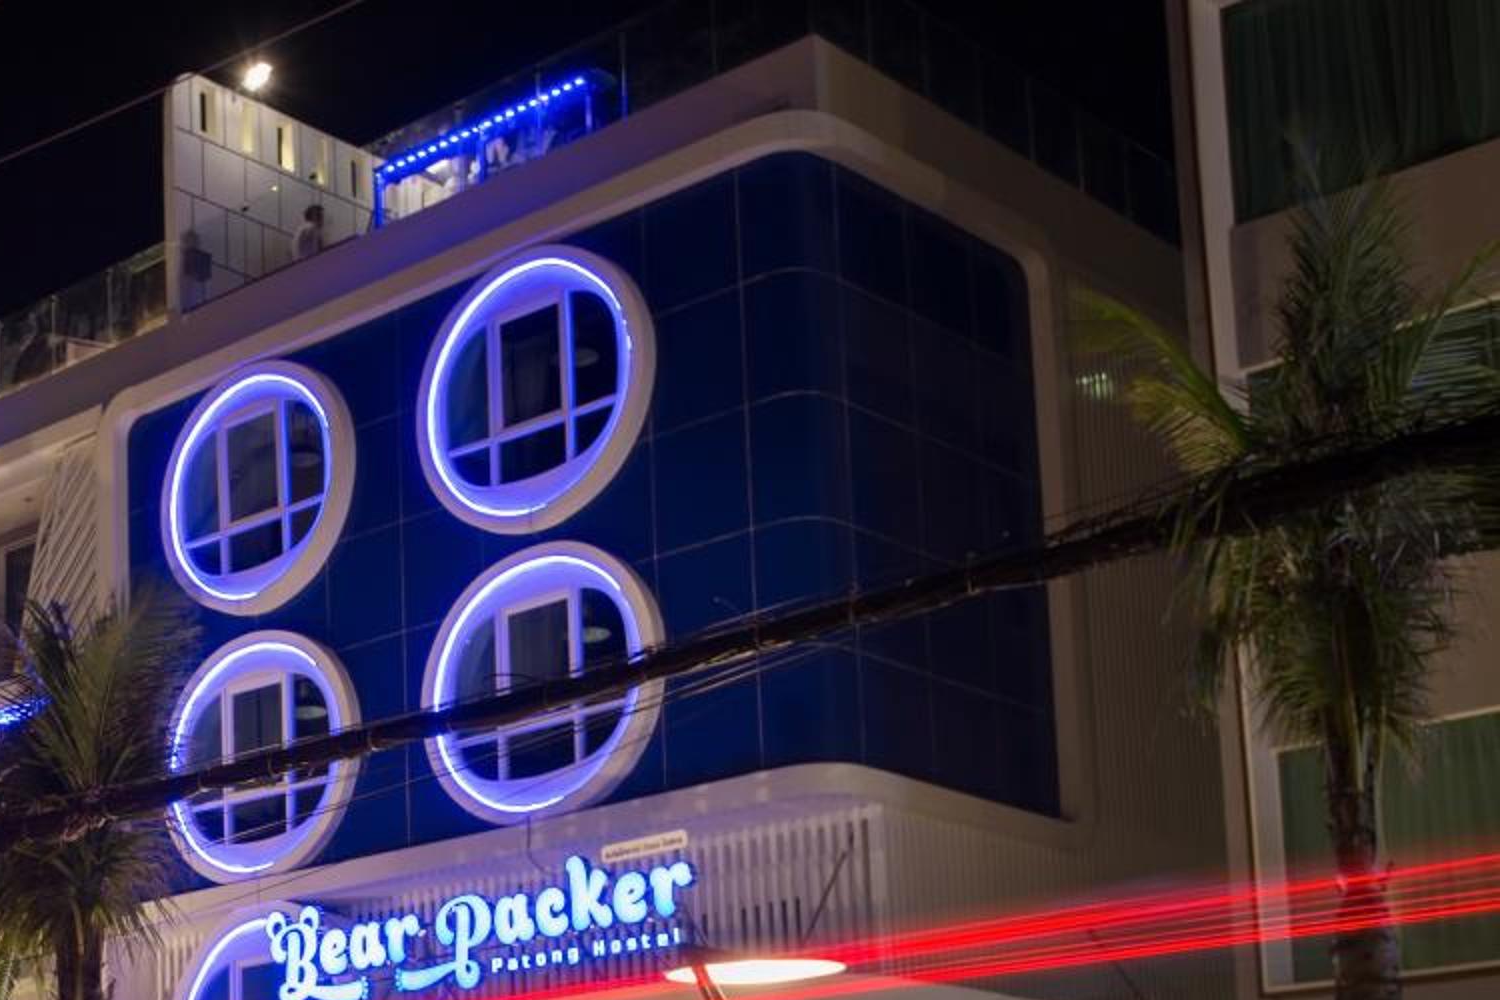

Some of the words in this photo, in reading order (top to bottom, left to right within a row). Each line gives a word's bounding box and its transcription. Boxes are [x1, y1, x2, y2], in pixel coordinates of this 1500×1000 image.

[397, 855, 693, 989] Packer
[491, 947, 580, 973] Patong
[593, 927, 680, 957] Hostel
